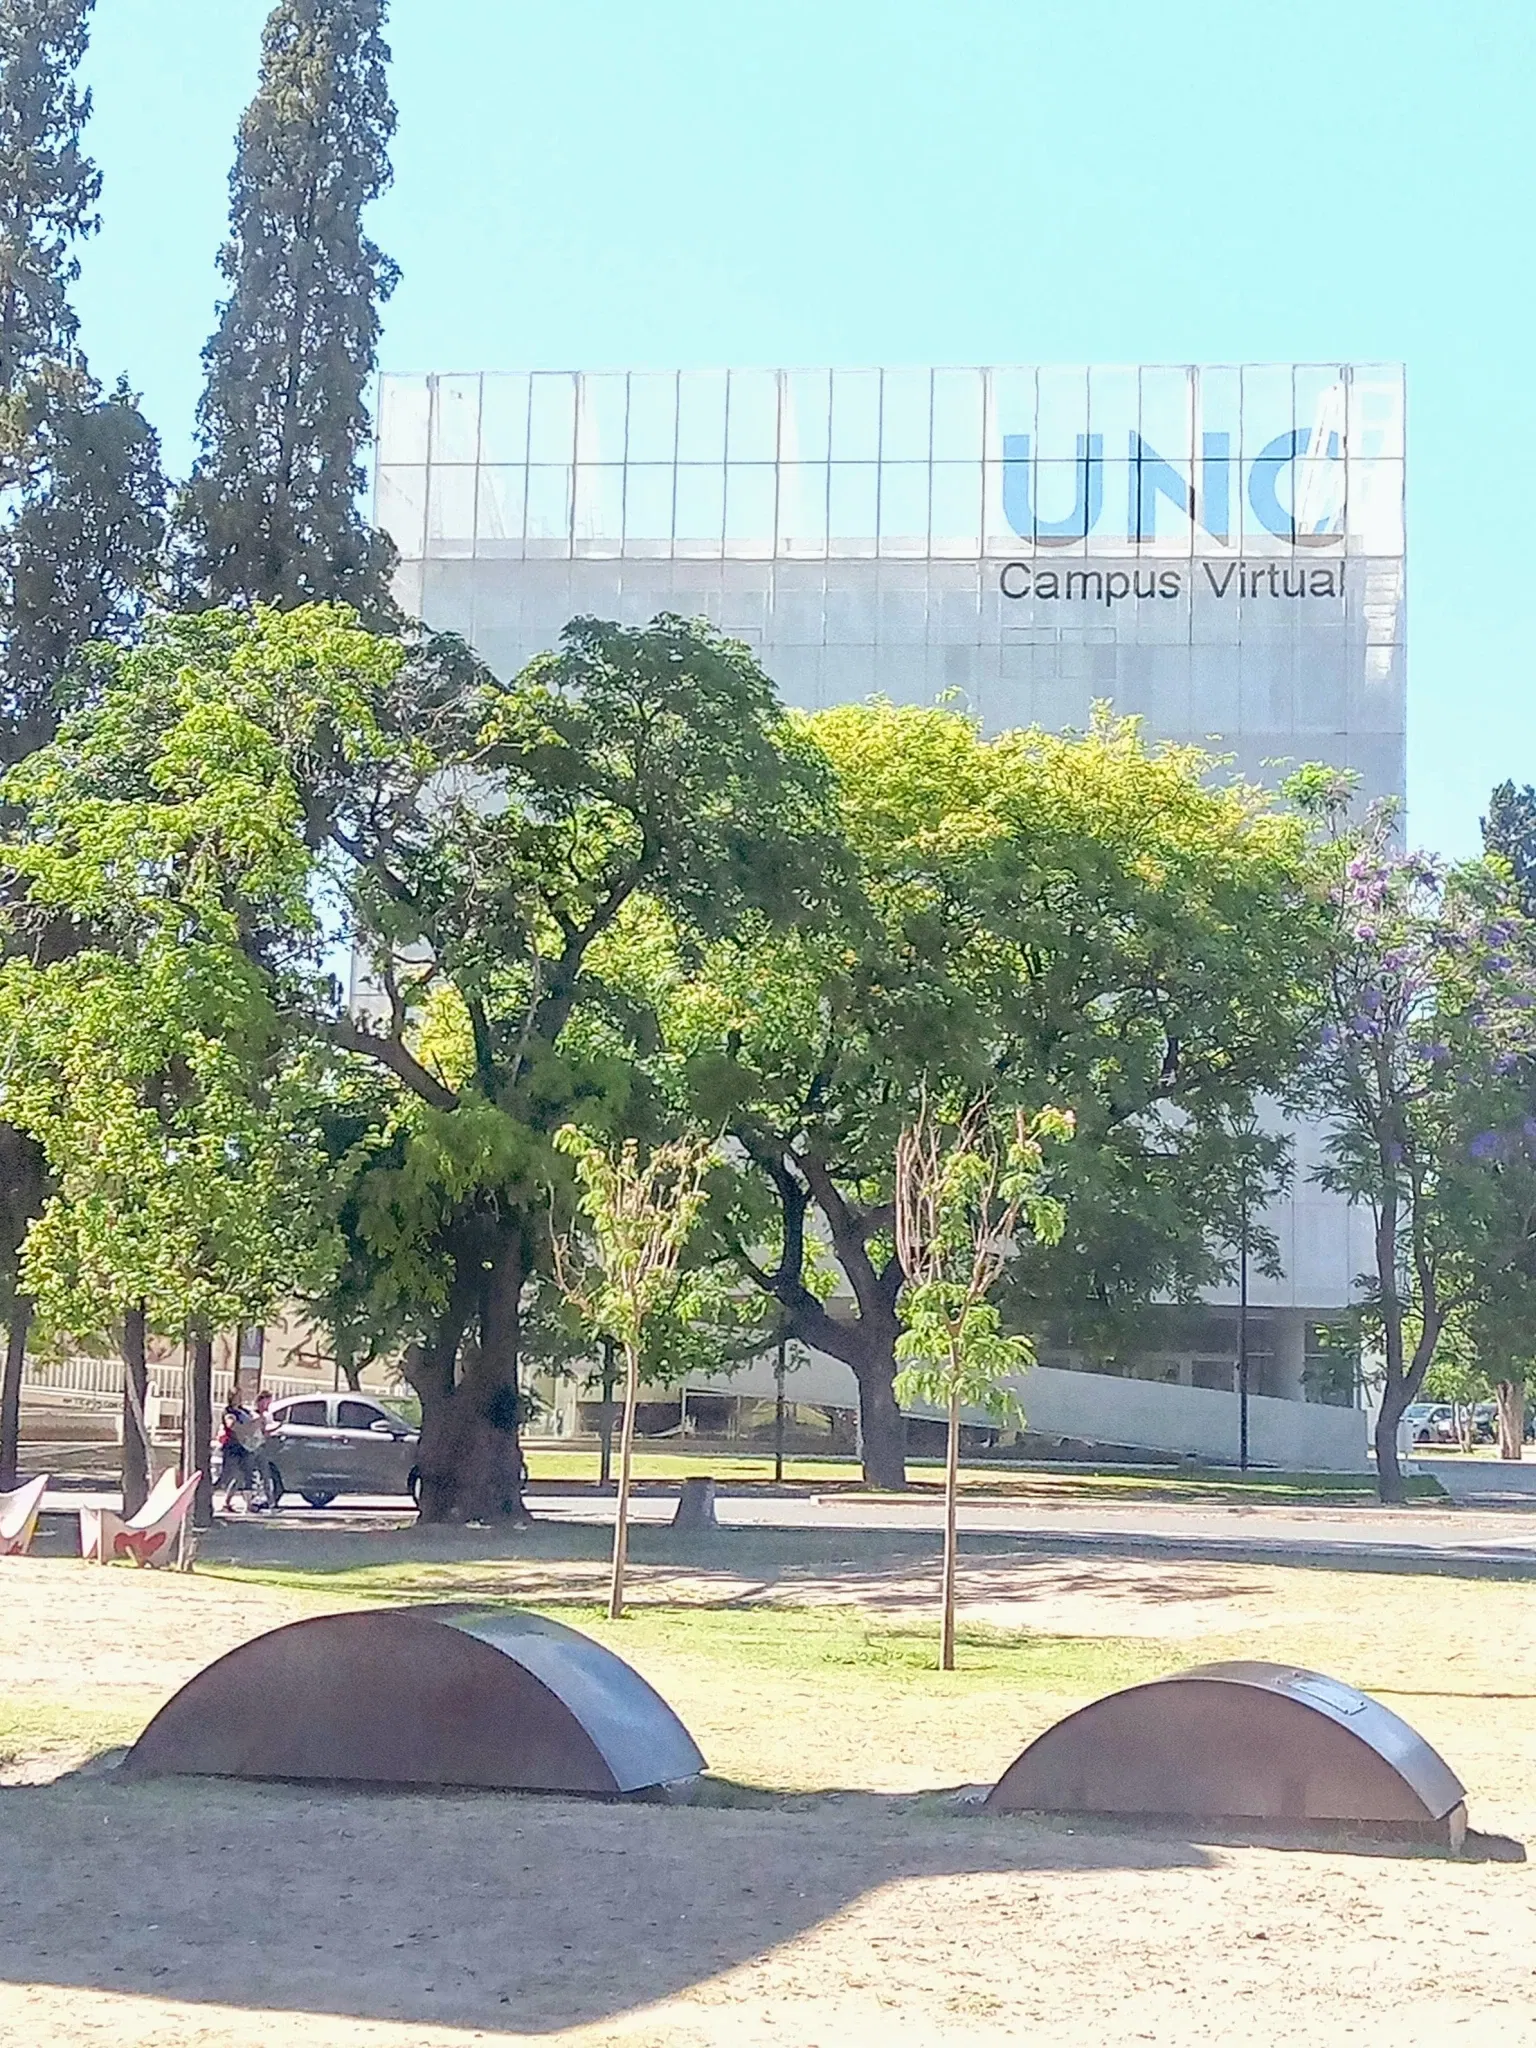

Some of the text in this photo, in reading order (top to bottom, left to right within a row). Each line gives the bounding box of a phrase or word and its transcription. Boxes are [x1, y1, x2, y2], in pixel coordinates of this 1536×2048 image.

[1002, 427, 1346, 548] UNC
[1000, 561, 1345, 607] Campus Virtual
